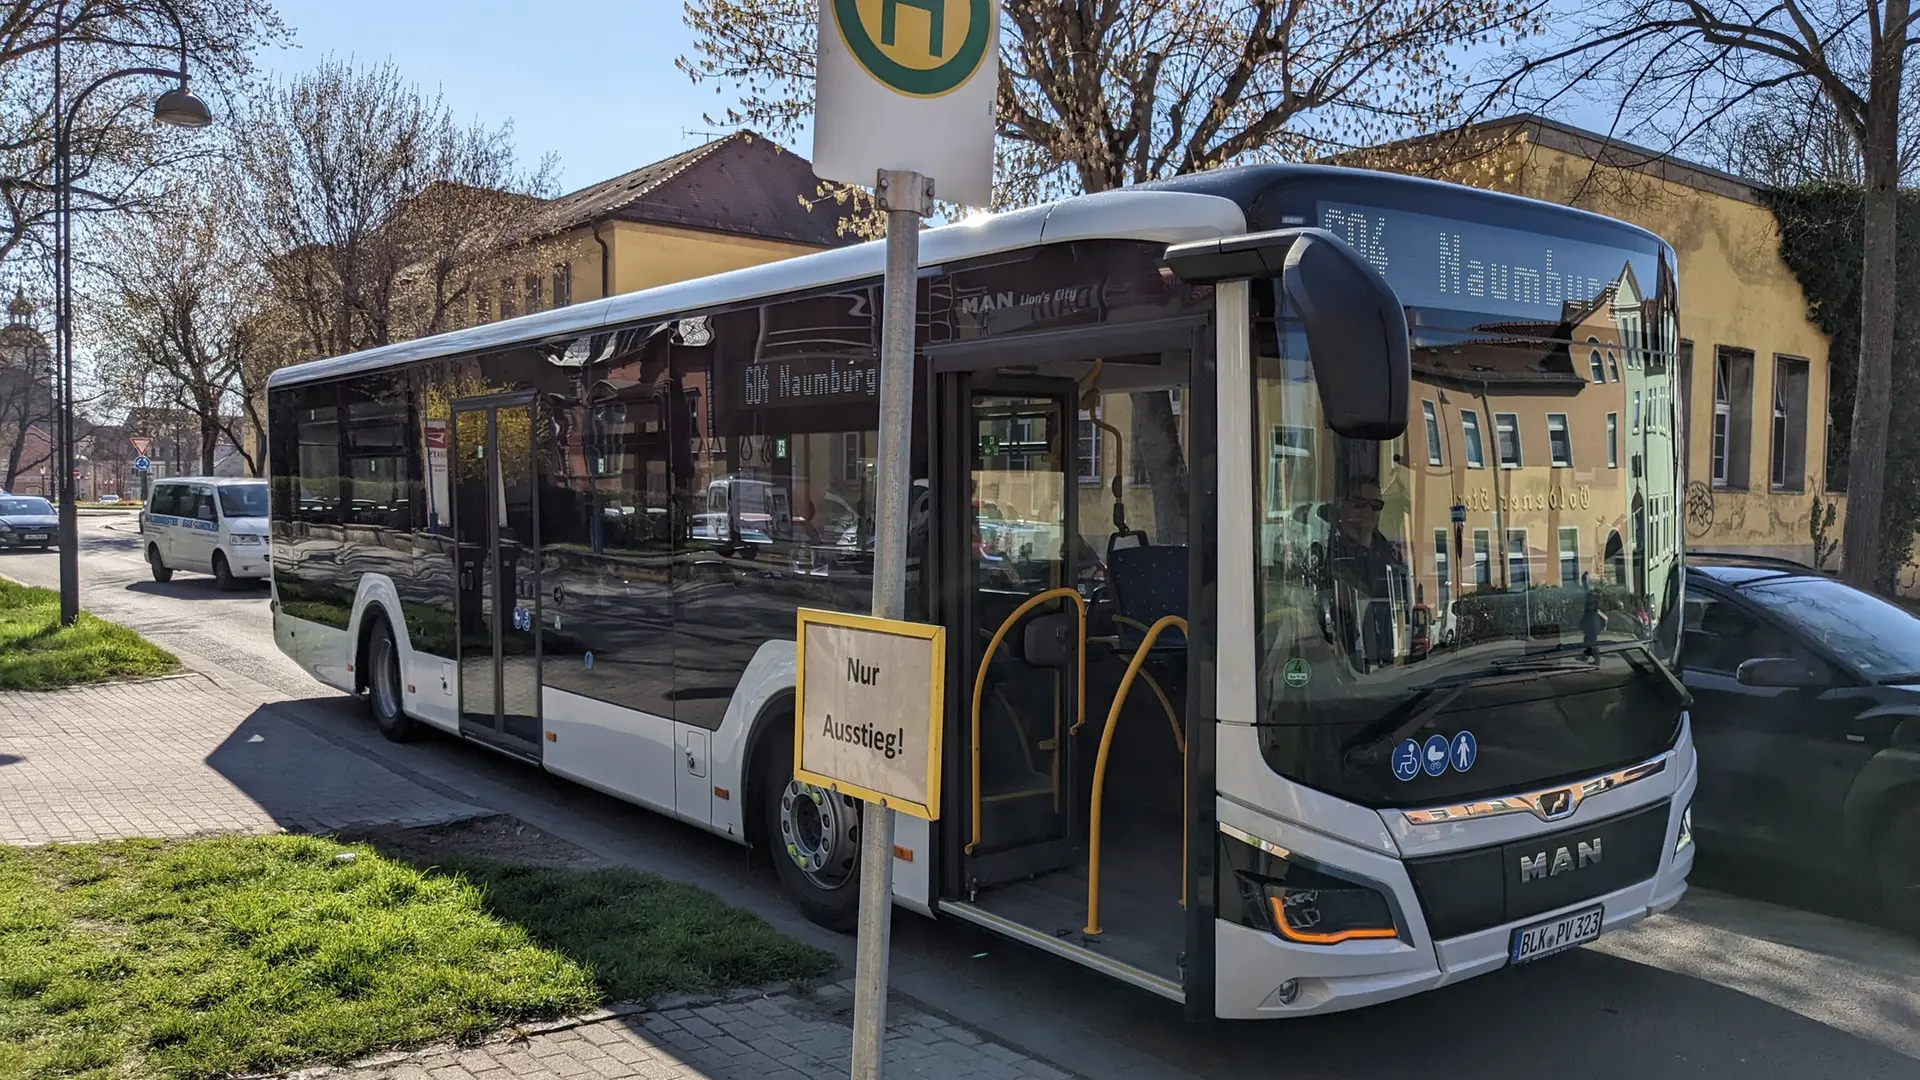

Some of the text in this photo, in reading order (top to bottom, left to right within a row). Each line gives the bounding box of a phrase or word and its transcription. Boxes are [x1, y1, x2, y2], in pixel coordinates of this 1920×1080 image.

[962, 288, 1077, 314] MAN Lion's City
[745, 359, 876, 405] 604 Naumburg
[847, 657, 880, 686] Nur
[1293, 660, 1302, 673] 4
[822, 714, 904, 759] Ausstieg!
[1520, 838, 1602, 884] MAN
[1521, 926, 1549, 956] BLK
[1556, 919, 1575, 945] PV
[1575, 911, 1600, 939] 323
